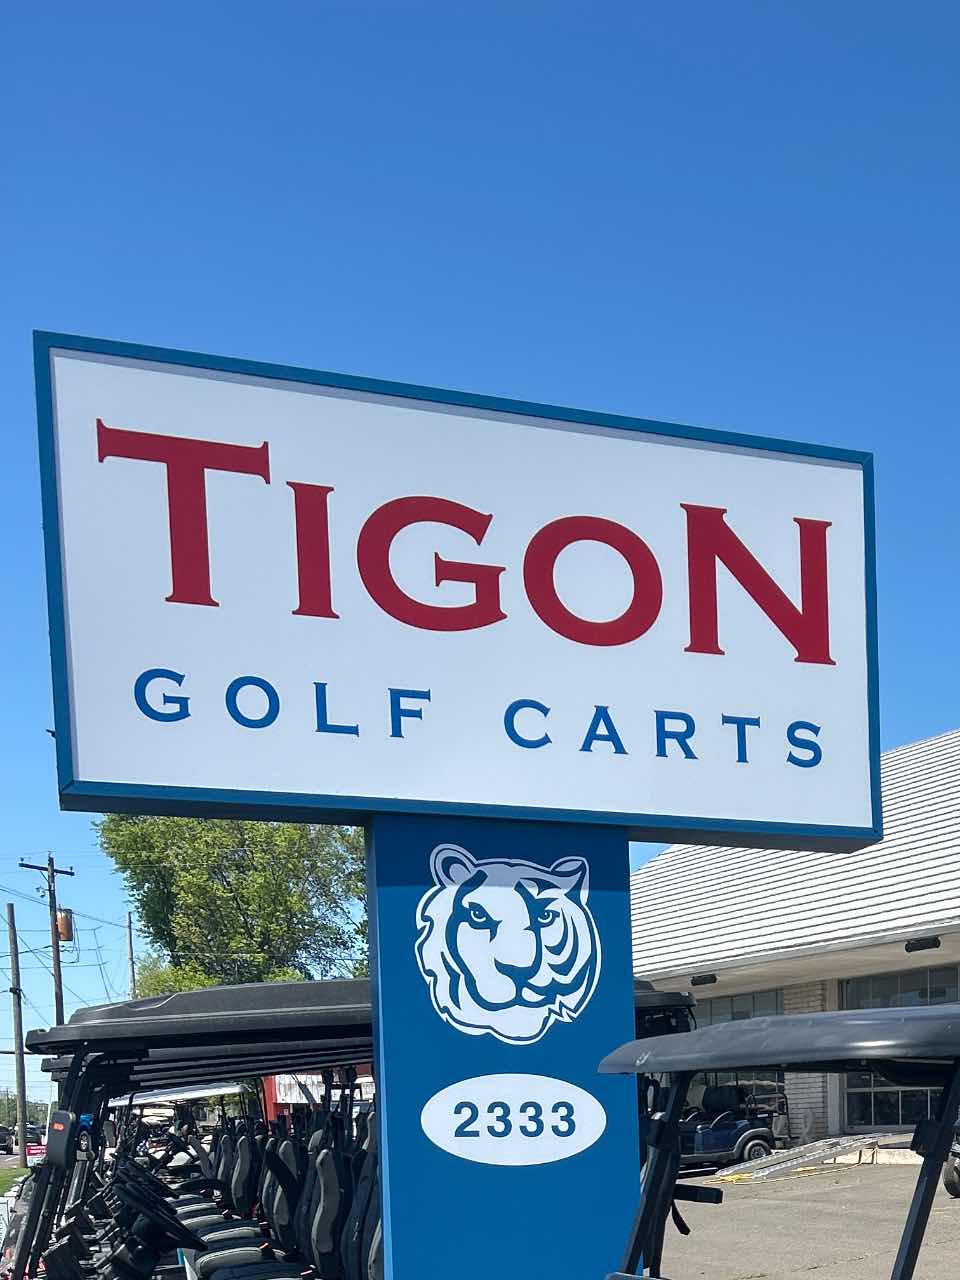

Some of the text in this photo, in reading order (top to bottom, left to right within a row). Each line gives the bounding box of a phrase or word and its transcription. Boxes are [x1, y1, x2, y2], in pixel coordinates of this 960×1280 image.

[97, 418, 836, 665] TIGON
[133, 667, 823, 769] GOLF CARTS
[454, 1101, 576, 1138] 2333
